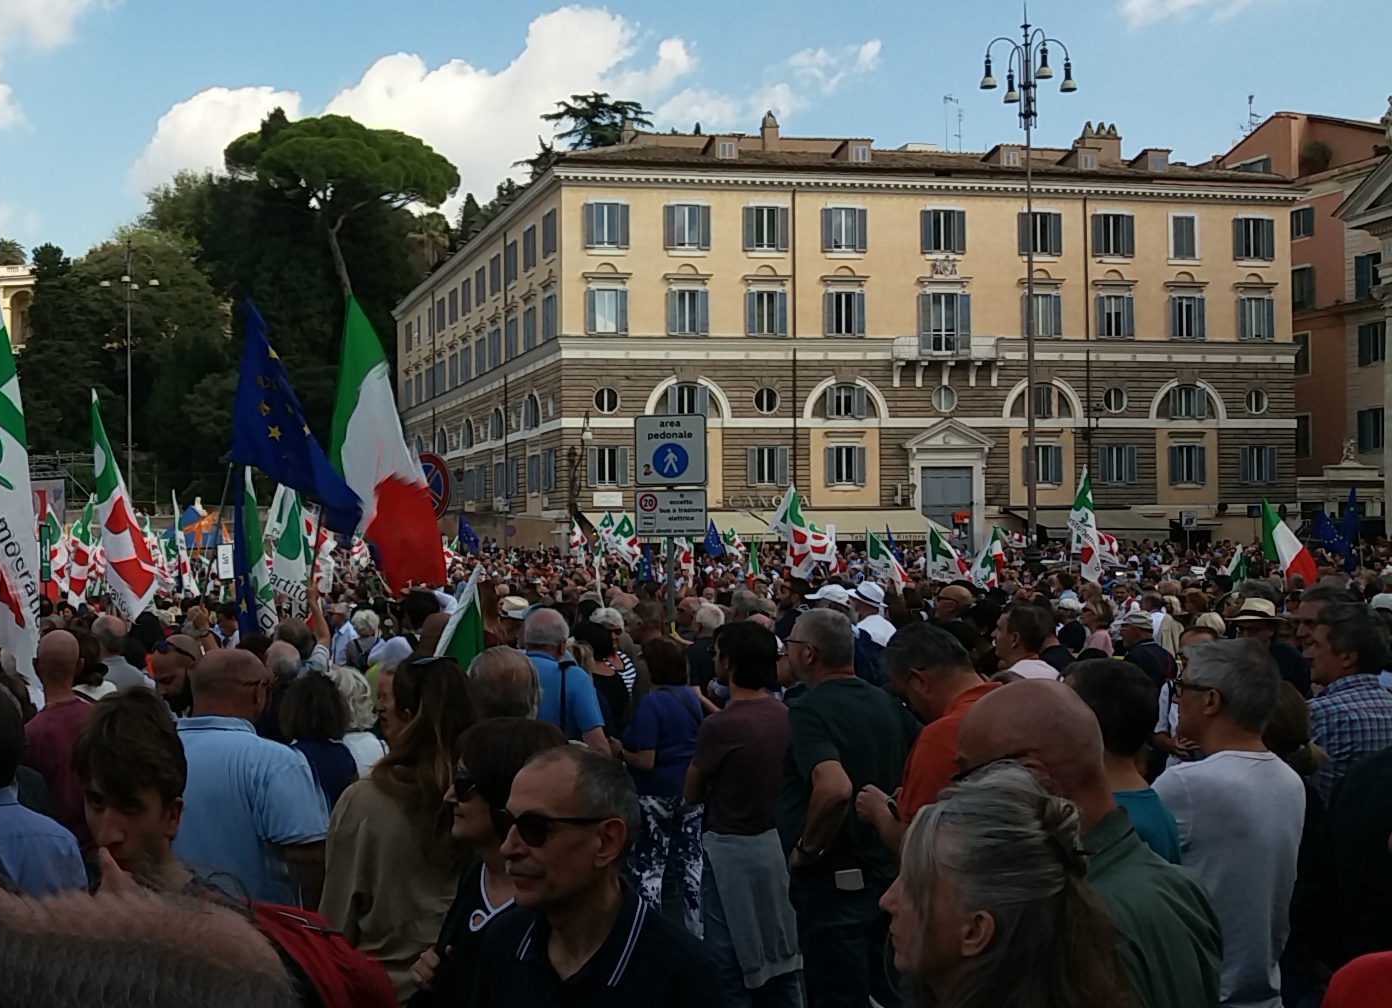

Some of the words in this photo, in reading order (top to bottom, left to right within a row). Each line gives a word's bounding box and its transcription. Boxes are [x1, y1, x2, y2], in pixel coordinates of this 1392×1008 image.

[659, 420, 681, 428] area
[647, 430, 693, 440] pedonale
[643, 499, 654, 507] 20
[728, 494, 812, 508] CANOA
